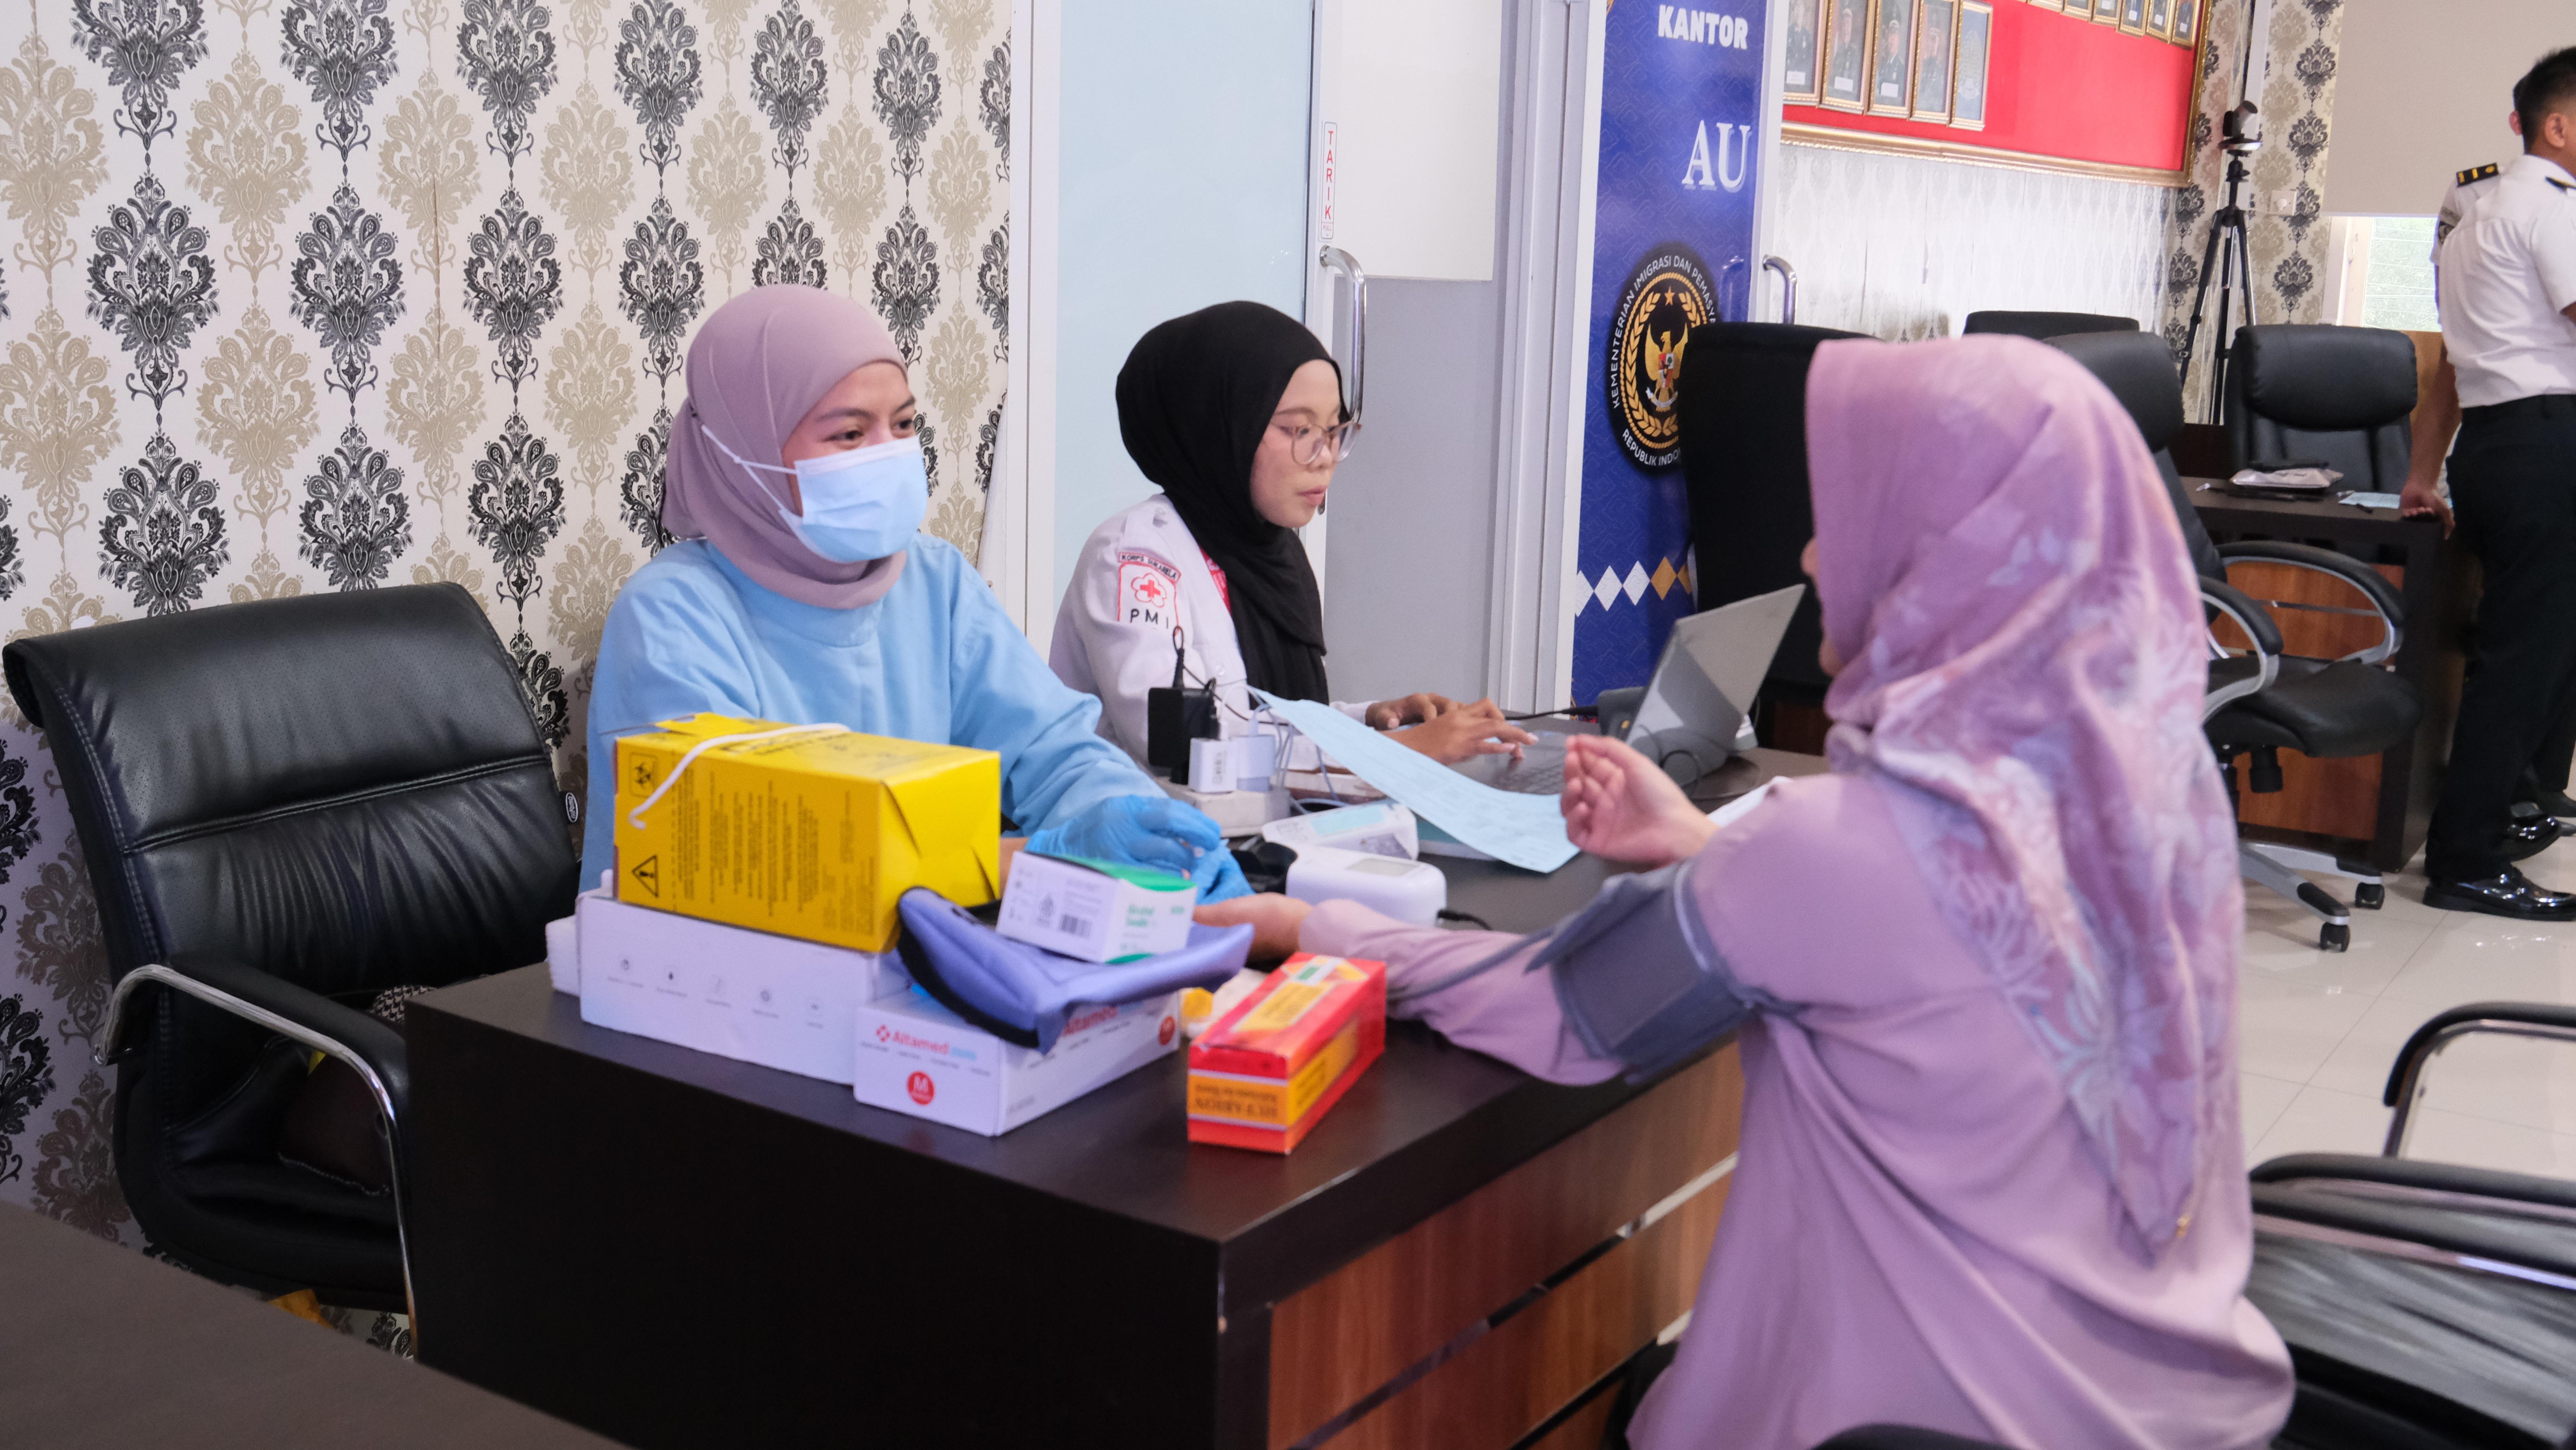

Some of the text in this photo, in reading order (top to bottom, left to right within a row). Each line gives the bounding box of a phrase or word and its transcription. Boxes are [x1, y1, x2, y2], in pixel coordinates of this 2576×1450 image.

[1658, 4, 1748, 50] KANTOR
[1325, 130, 1334, 220] TARIK
[1681, 119, 1751, 192] AU
[1610, 255, 1716, 409] KEMENTERIAN IMIGRASI DAN PEMASYA
[1622, 428, 1681, 466] REPUBLIK INDO
